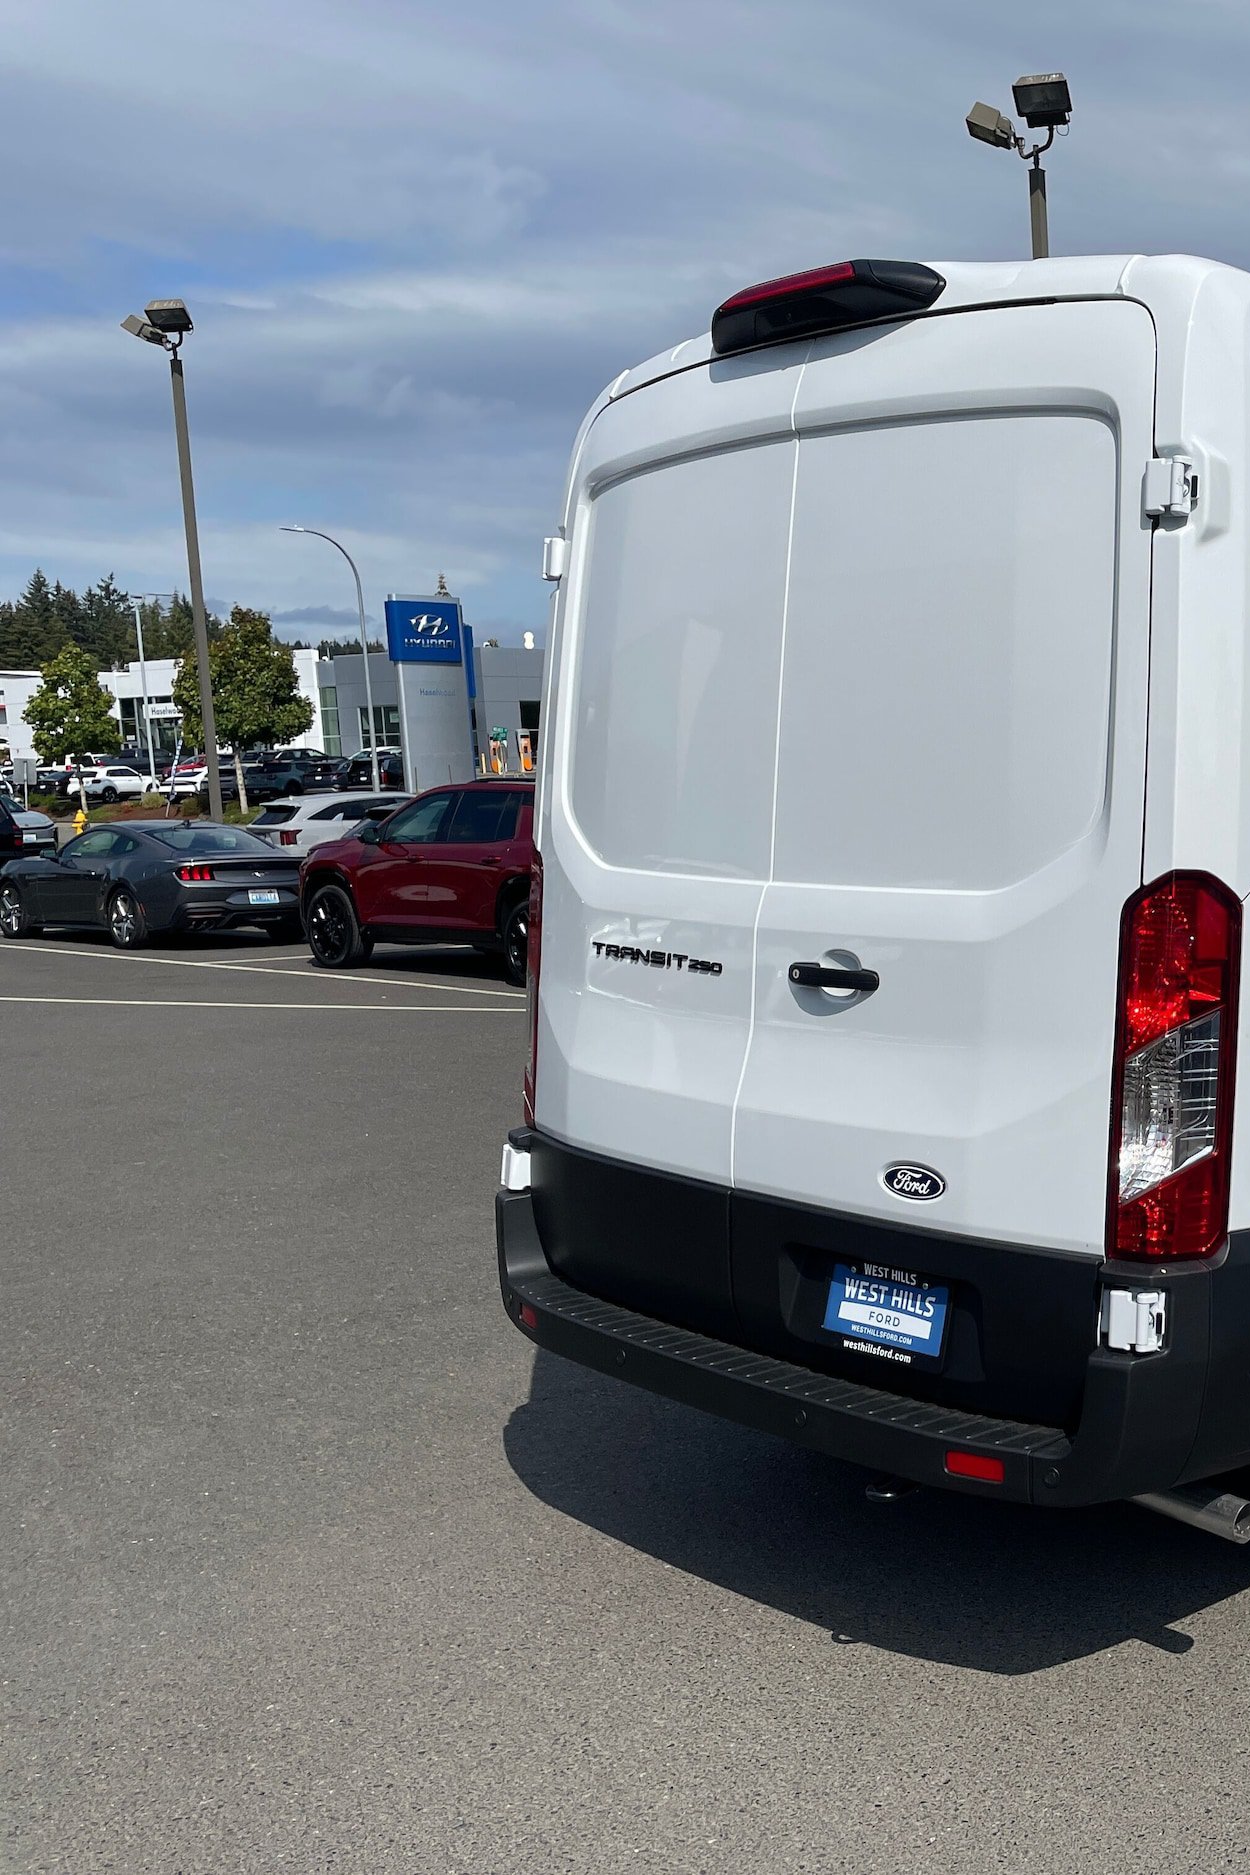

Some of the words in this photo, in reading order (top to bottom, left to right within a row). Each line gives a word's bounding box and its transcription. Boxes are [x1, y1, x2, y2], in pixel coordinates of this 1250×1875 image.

[592, 941, 688, 971] TRANSIT
[688, 958, 723, 977] 250
[893, 1169, 931, 1195] Ford
[863, 1262, 889, 1279] WEST
[891, 1269, 917, 1286] HILLS
[844, 1277, 889, 1305] WEST
[891, 1289, 936, 1318] HILLS
[868, 1310, 901, 1327] FORD
[851, 1323, 912, 1346] WESTHILLSFORD.COM
[843, 1338, 912, 1364] westhillsford.com
